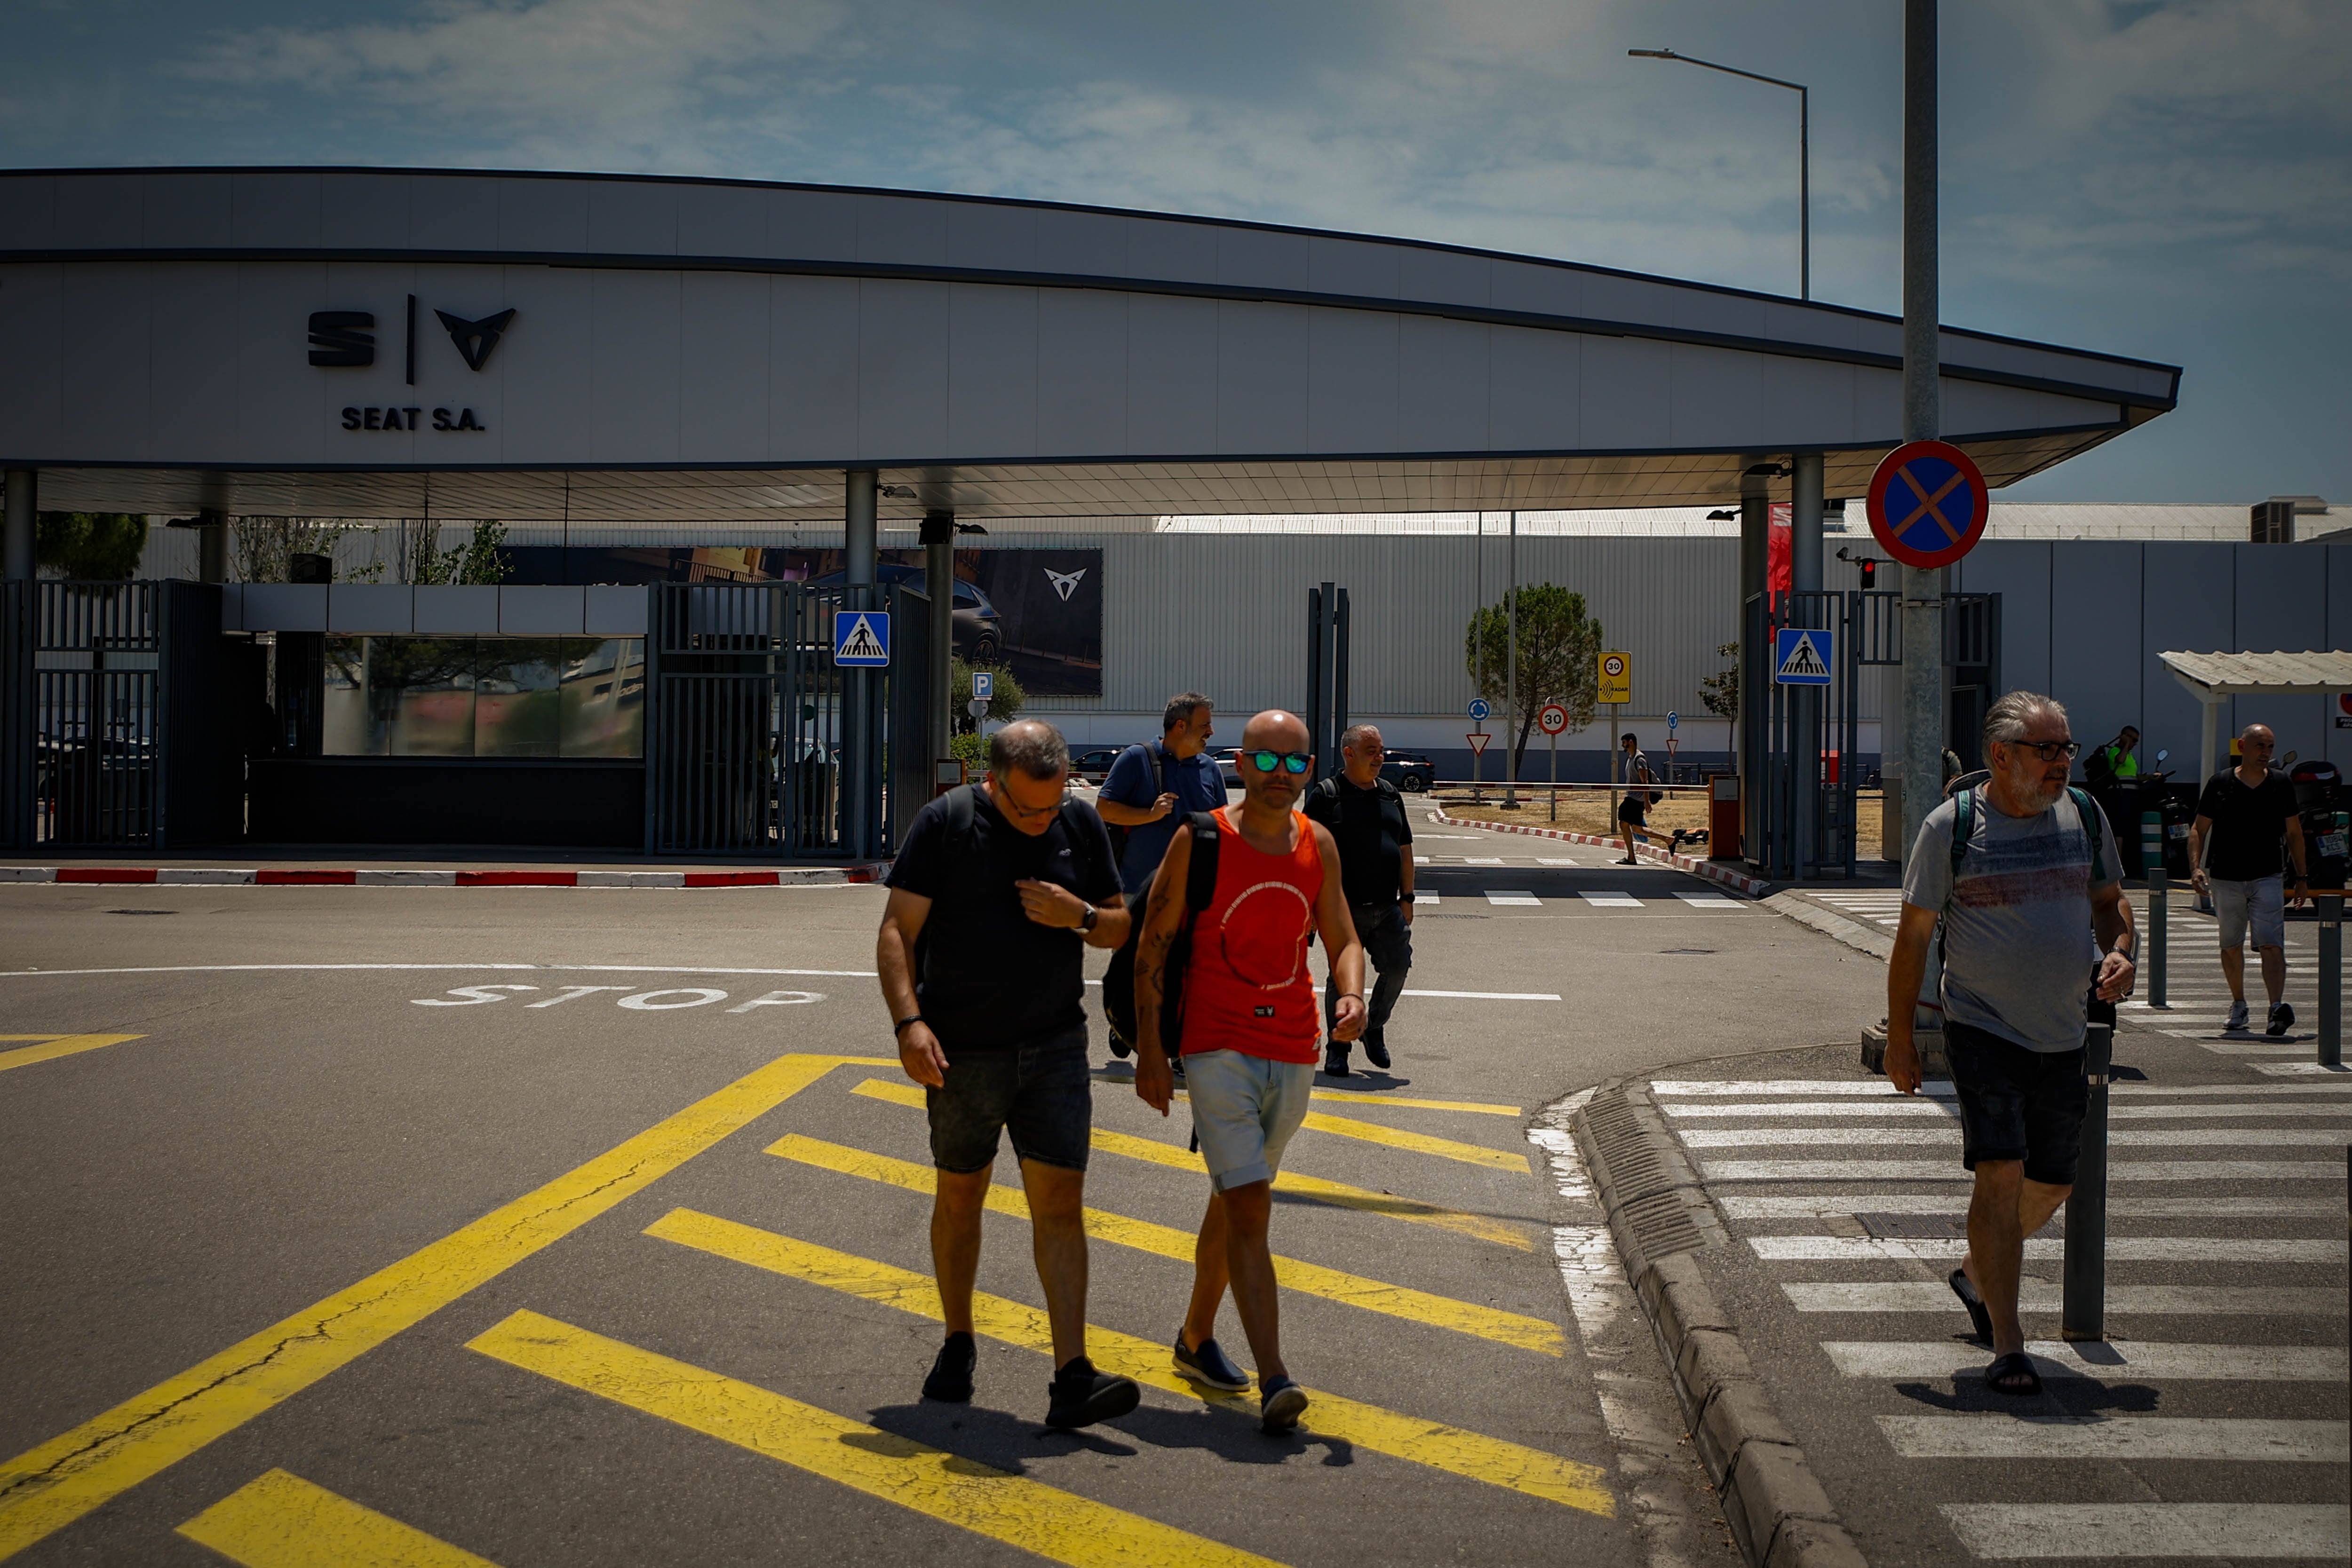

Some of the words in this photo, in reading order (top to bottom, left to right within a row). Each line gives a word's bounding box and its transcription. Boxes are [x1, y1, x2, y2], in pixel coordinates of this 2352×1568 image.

[342, 407, 421, 430] SEAT
[432, 407, 485, 430] S.A.
[977, 676, 989, 694] P
[1545, 714, 1561, 724] 30
[409, 983, 828, 1013] STOP
